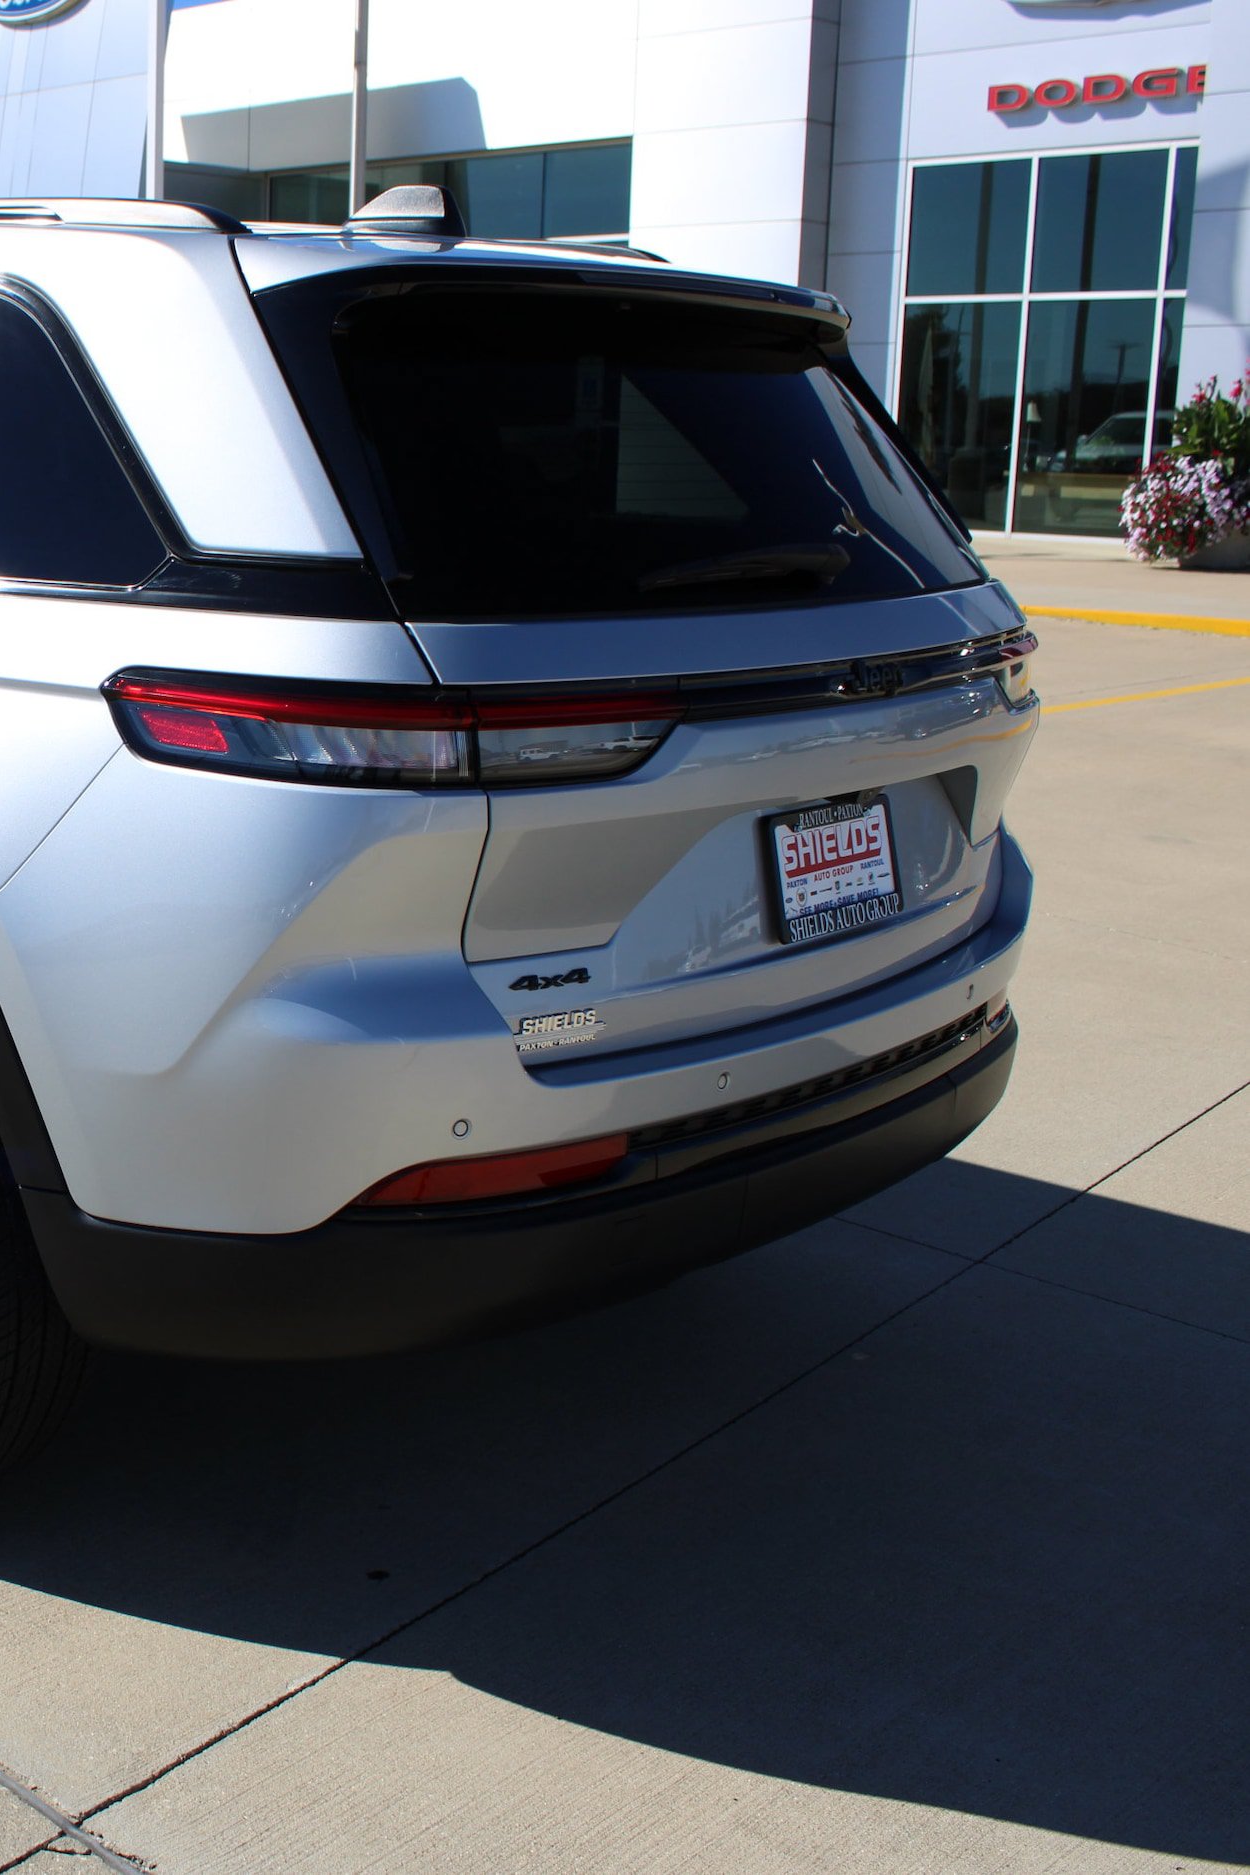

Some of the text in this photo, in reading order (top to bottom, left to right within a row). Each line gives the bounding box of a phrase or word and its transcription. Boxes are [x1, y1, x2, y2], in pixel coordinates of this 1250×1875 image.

[987, 64, 1207, 112] DODGE
[799, 803, 863, 828] RANTOUL PAXTON
[781, 815, 883, 872] SHIELDS
[813, 865, 854, 882] AUTO GROUP
[860, 858, 885, 870] RANTOUL
[786, 878, 808, 890] PAXTON
[789, 893, 900, 944] SHIELDS AUTO GROUP
[508, 967, 591, 991] 4x4
[522, 1008, 596, 1035] SHIELDS
[519, 1033, 596, 1051] PAXTON RANTOUL
